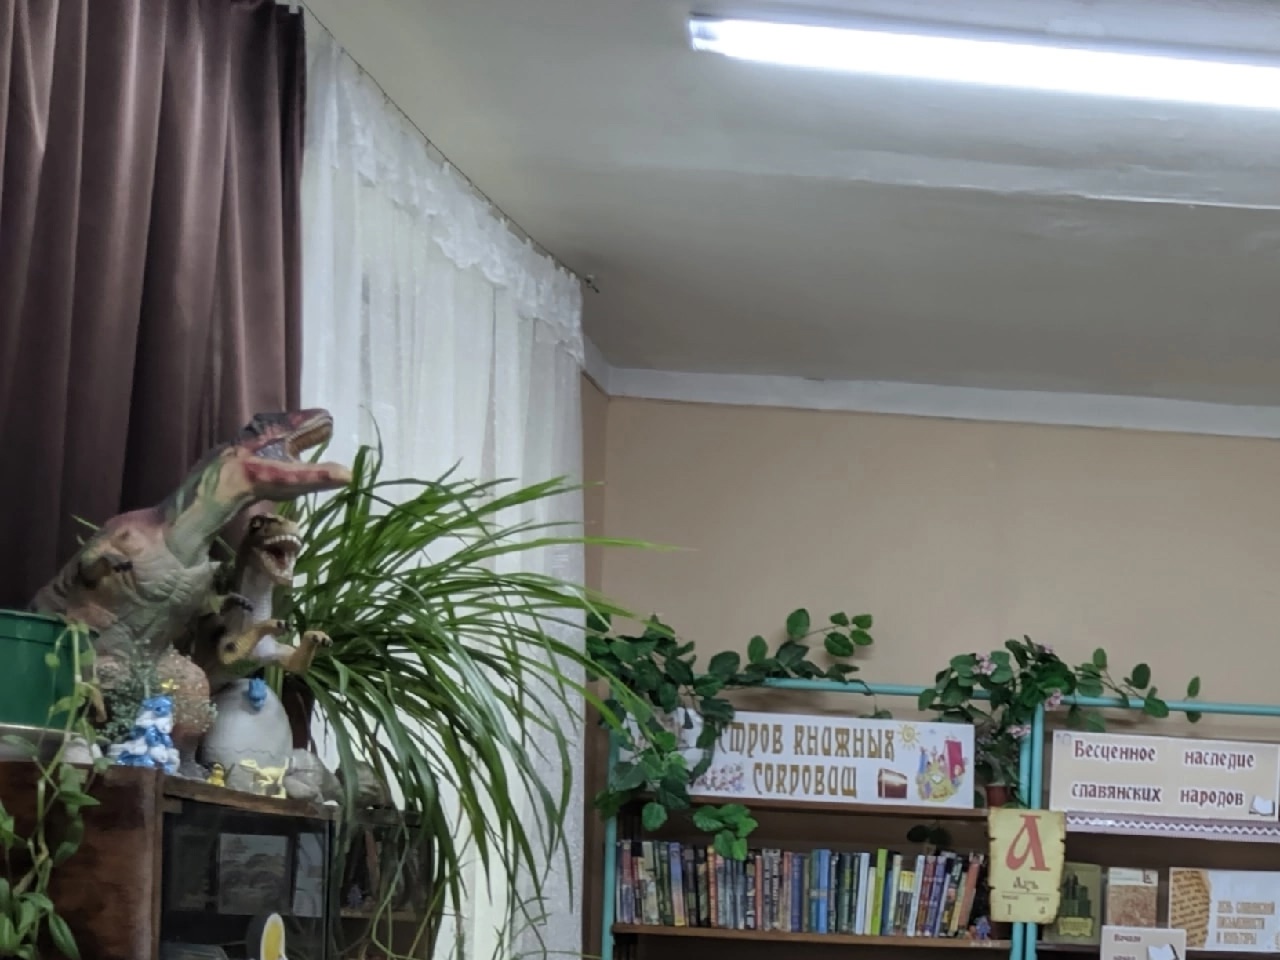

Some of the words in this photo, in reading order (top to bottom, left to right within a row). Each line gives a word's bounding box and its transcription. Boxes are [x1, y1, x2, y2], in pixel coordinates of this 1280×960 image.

[718, 722, 783, 758] СТРОВ
[1074, 740, 1156, 762] Бесценное
[1185, 750, 1254, 771] наследие
[1072, 782, 1161, 803] славянских
[1180, 787, 1245, 808] народов
